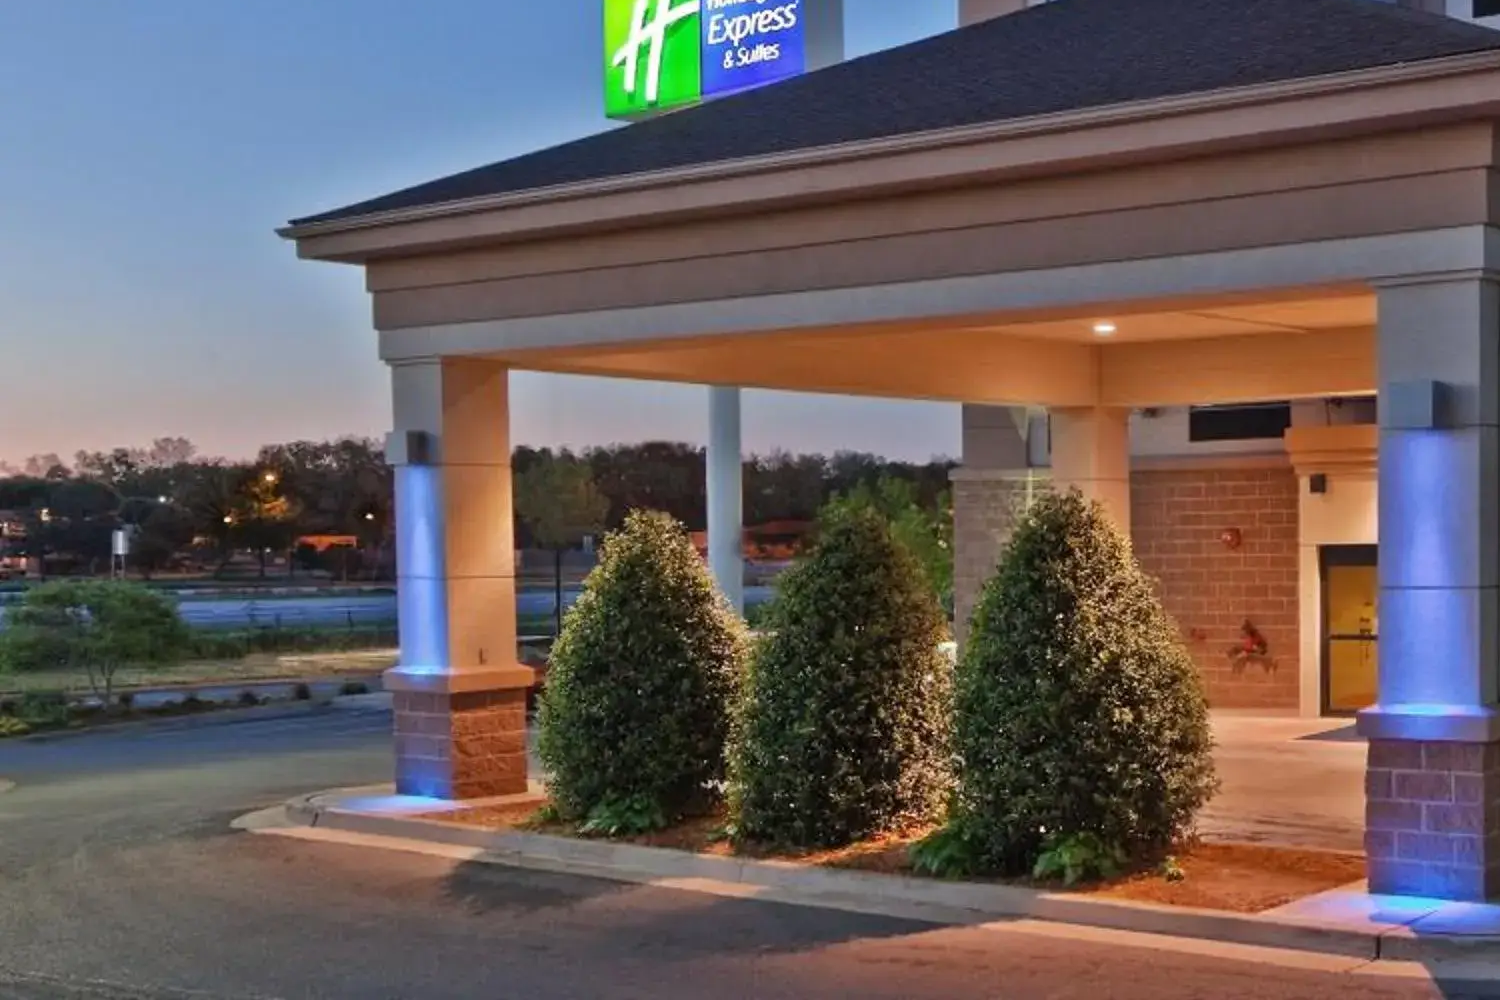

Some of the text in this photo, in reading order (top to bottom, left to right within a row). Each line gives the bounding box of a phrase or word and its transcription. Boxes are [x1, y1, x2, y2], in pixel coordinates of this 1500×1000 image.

[707, 3, 798, 46] Express
[723, 43, 780, 69] & Suites
